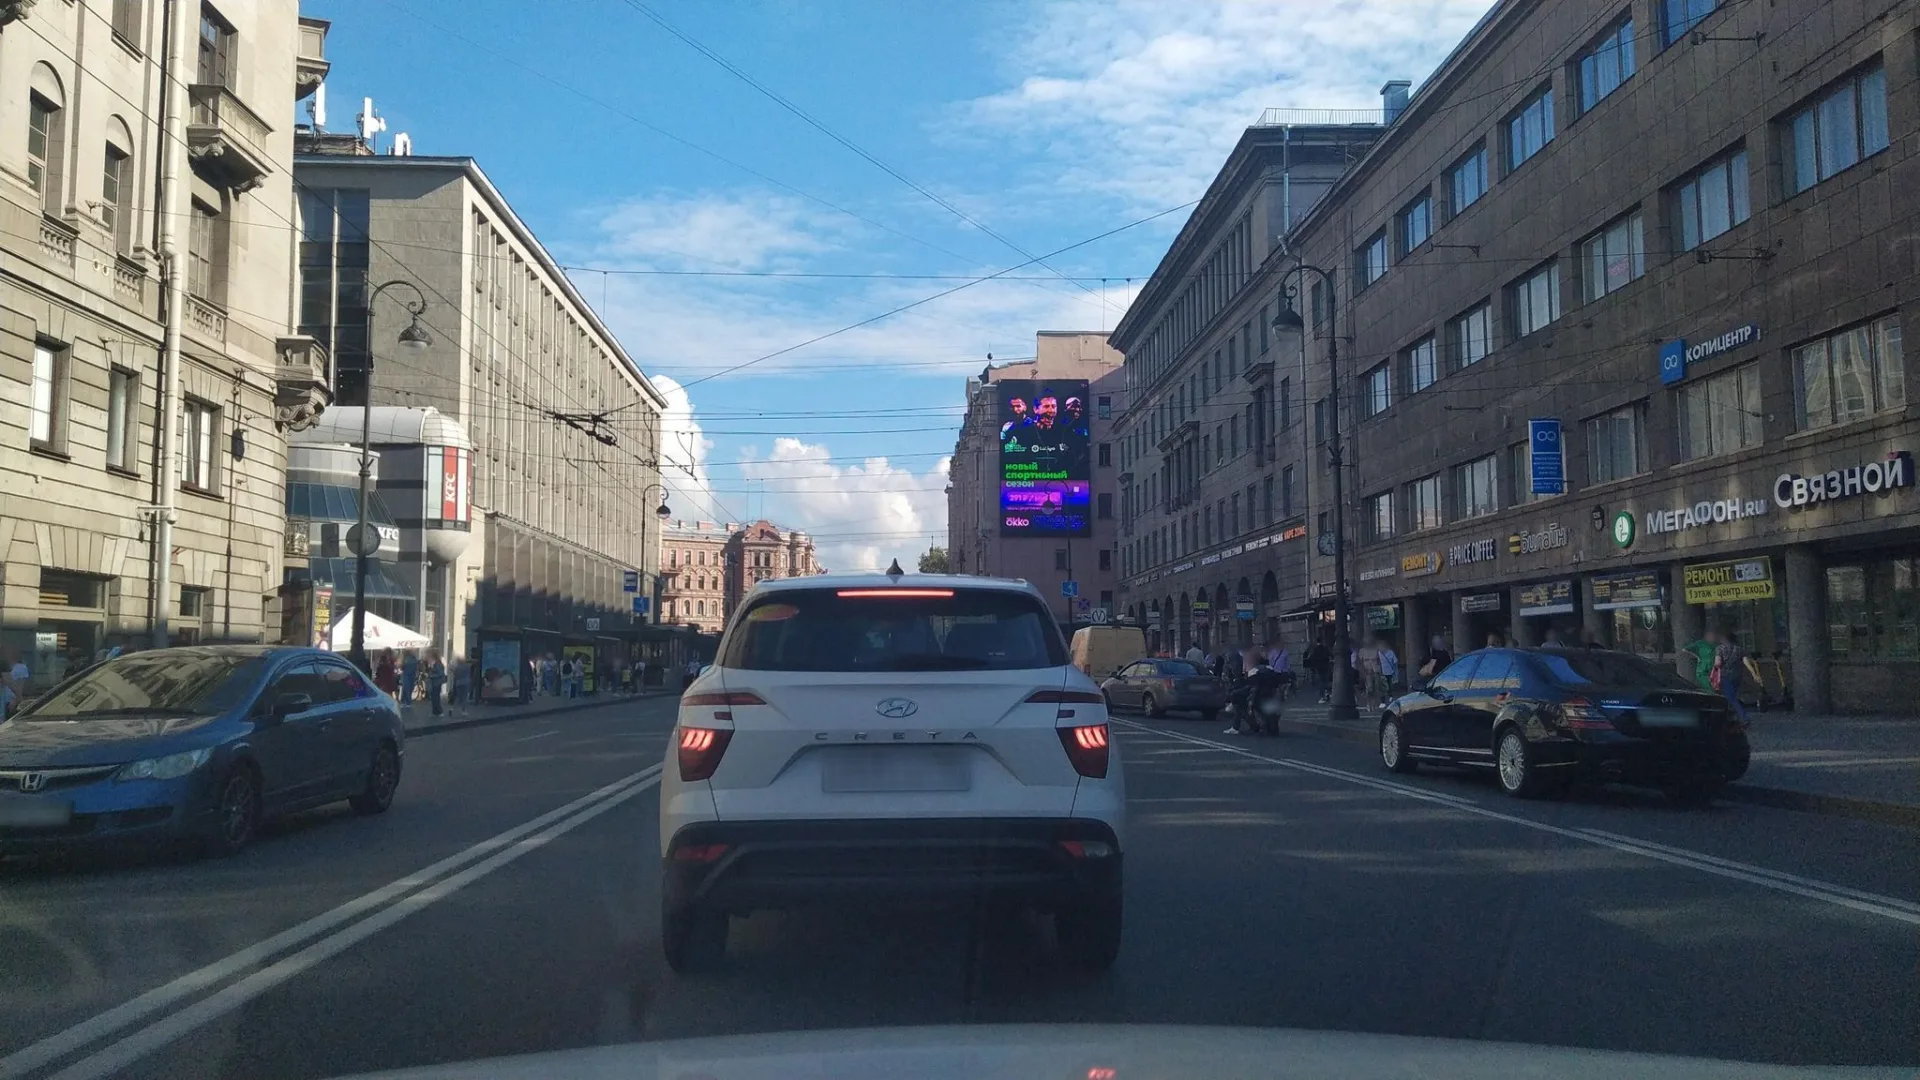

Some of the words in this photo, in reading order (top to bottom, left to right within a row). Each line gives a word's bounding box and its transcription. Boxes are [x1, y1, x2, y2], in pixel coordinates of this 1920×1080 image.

[1685, 324, 1753, 364] КОПИЦЕНТР
[1005, 462, 1038, 471] новый
[1005, 470, 1068, 481] спортивный
[445, 472, 456, 503] KFC
[377, 526, 400, 541] KFC
[1453, 542, 1472, 566] PRICE
[1472, 539, 1495, 562] COFFEE
[1403, 554, 1428, 571] РЕМОНТ
[1684, 566, 1731, 585] РЕМОНТ
[1694, 589, 1712, 599] этаж
[1716, 586, 1744, 598] центр.
[1744, 584, 1765, 595] вход
[815, 731, 978, 741] CRETA
